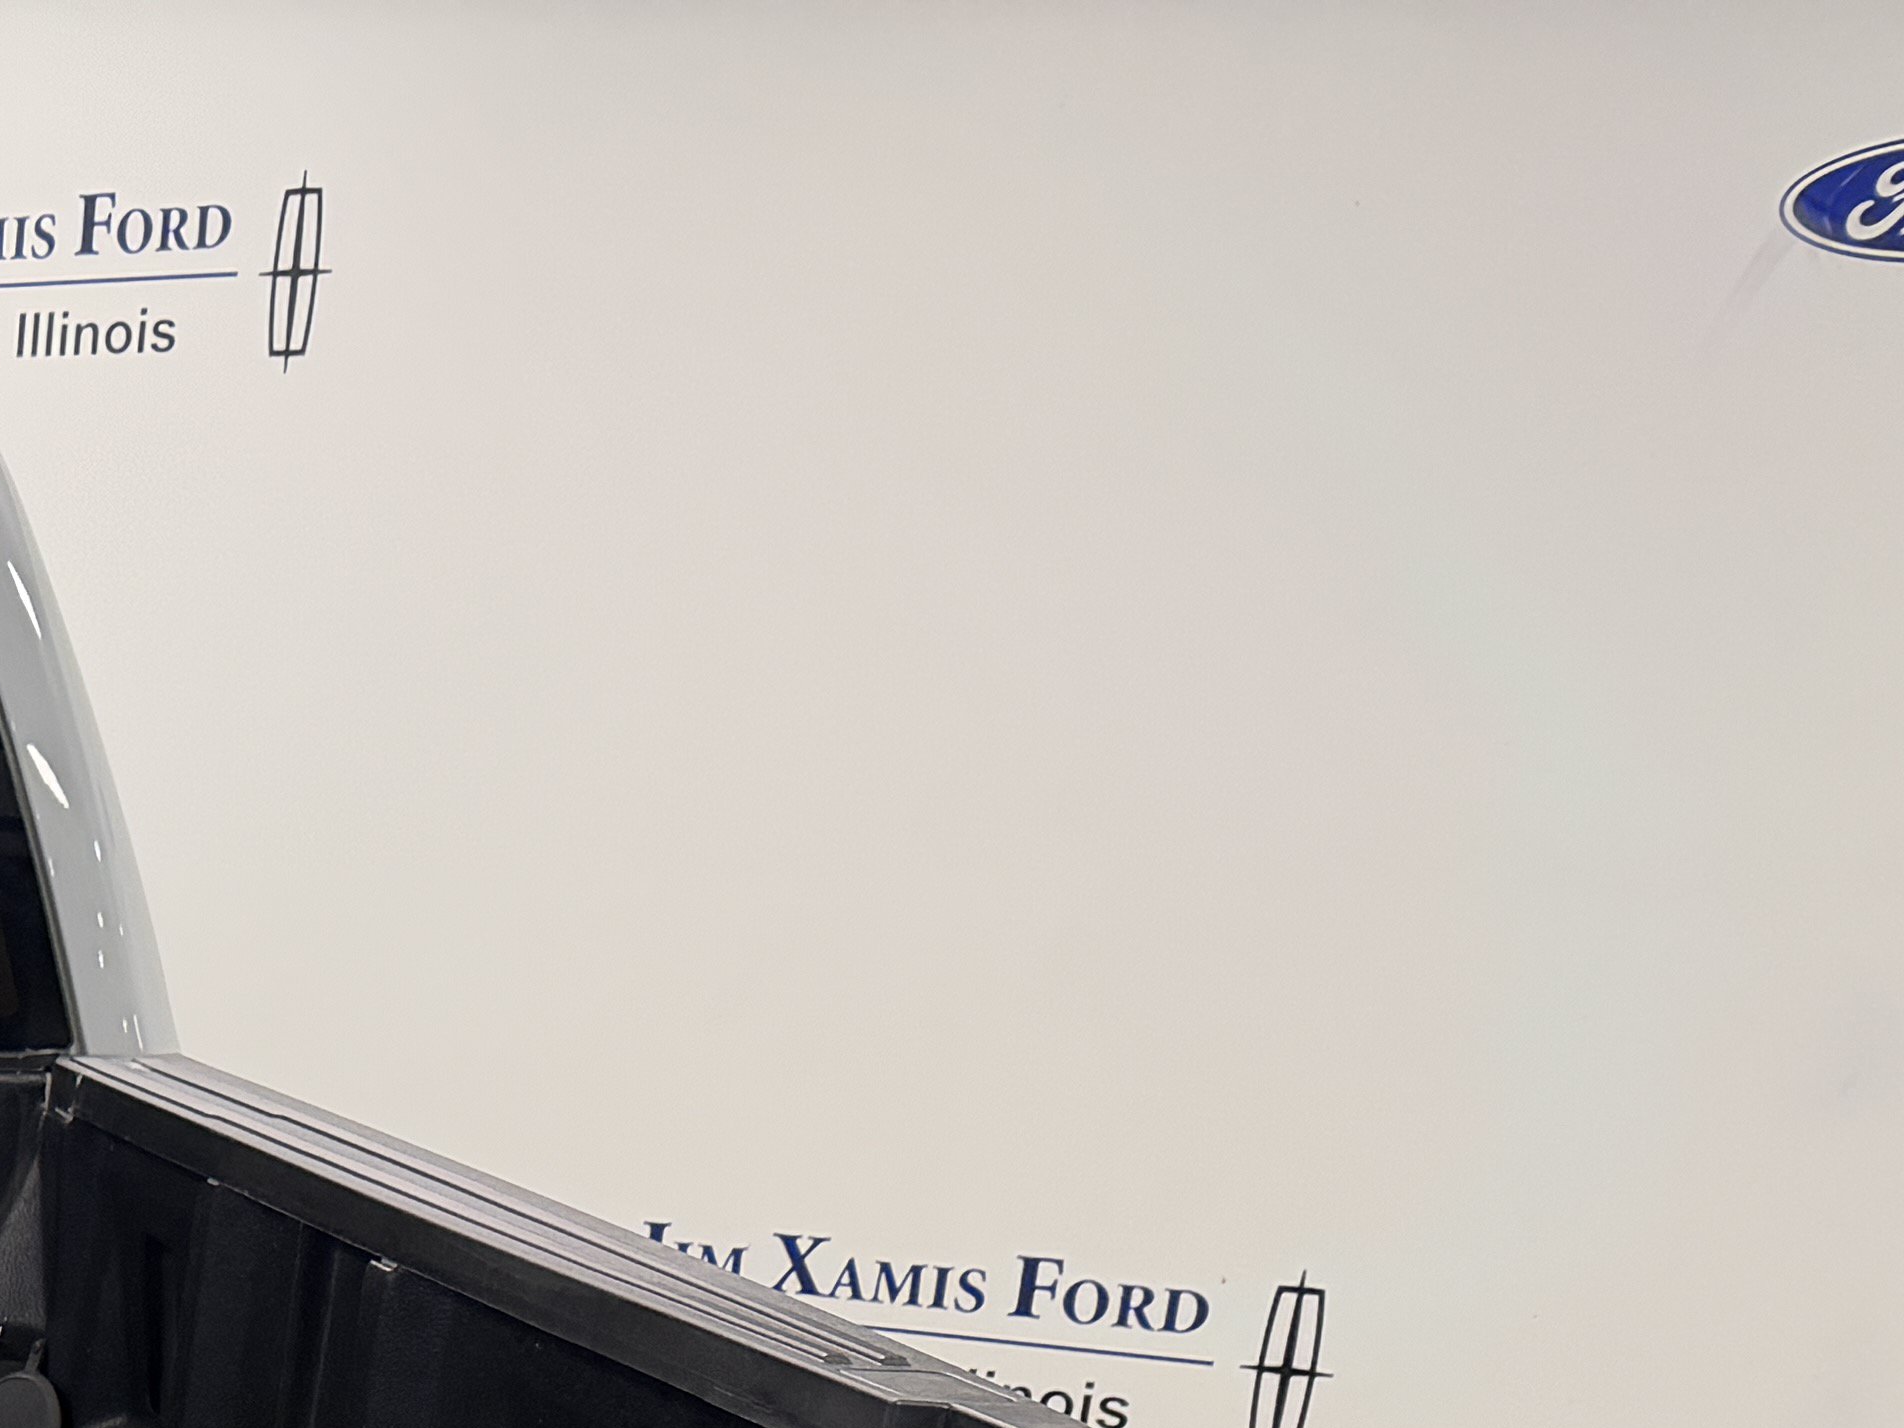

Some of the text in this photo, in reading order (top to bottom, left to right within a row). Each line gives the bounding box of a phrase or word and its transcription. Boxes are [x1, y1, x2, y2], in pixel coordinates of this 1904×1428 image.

[74, 191, 232, 256] FORD
[16, 307, 177, 358] Illinois
[771, 1232, 987, 1314] XAMIS
[1007, 1255, 1210, 1334] FORD
